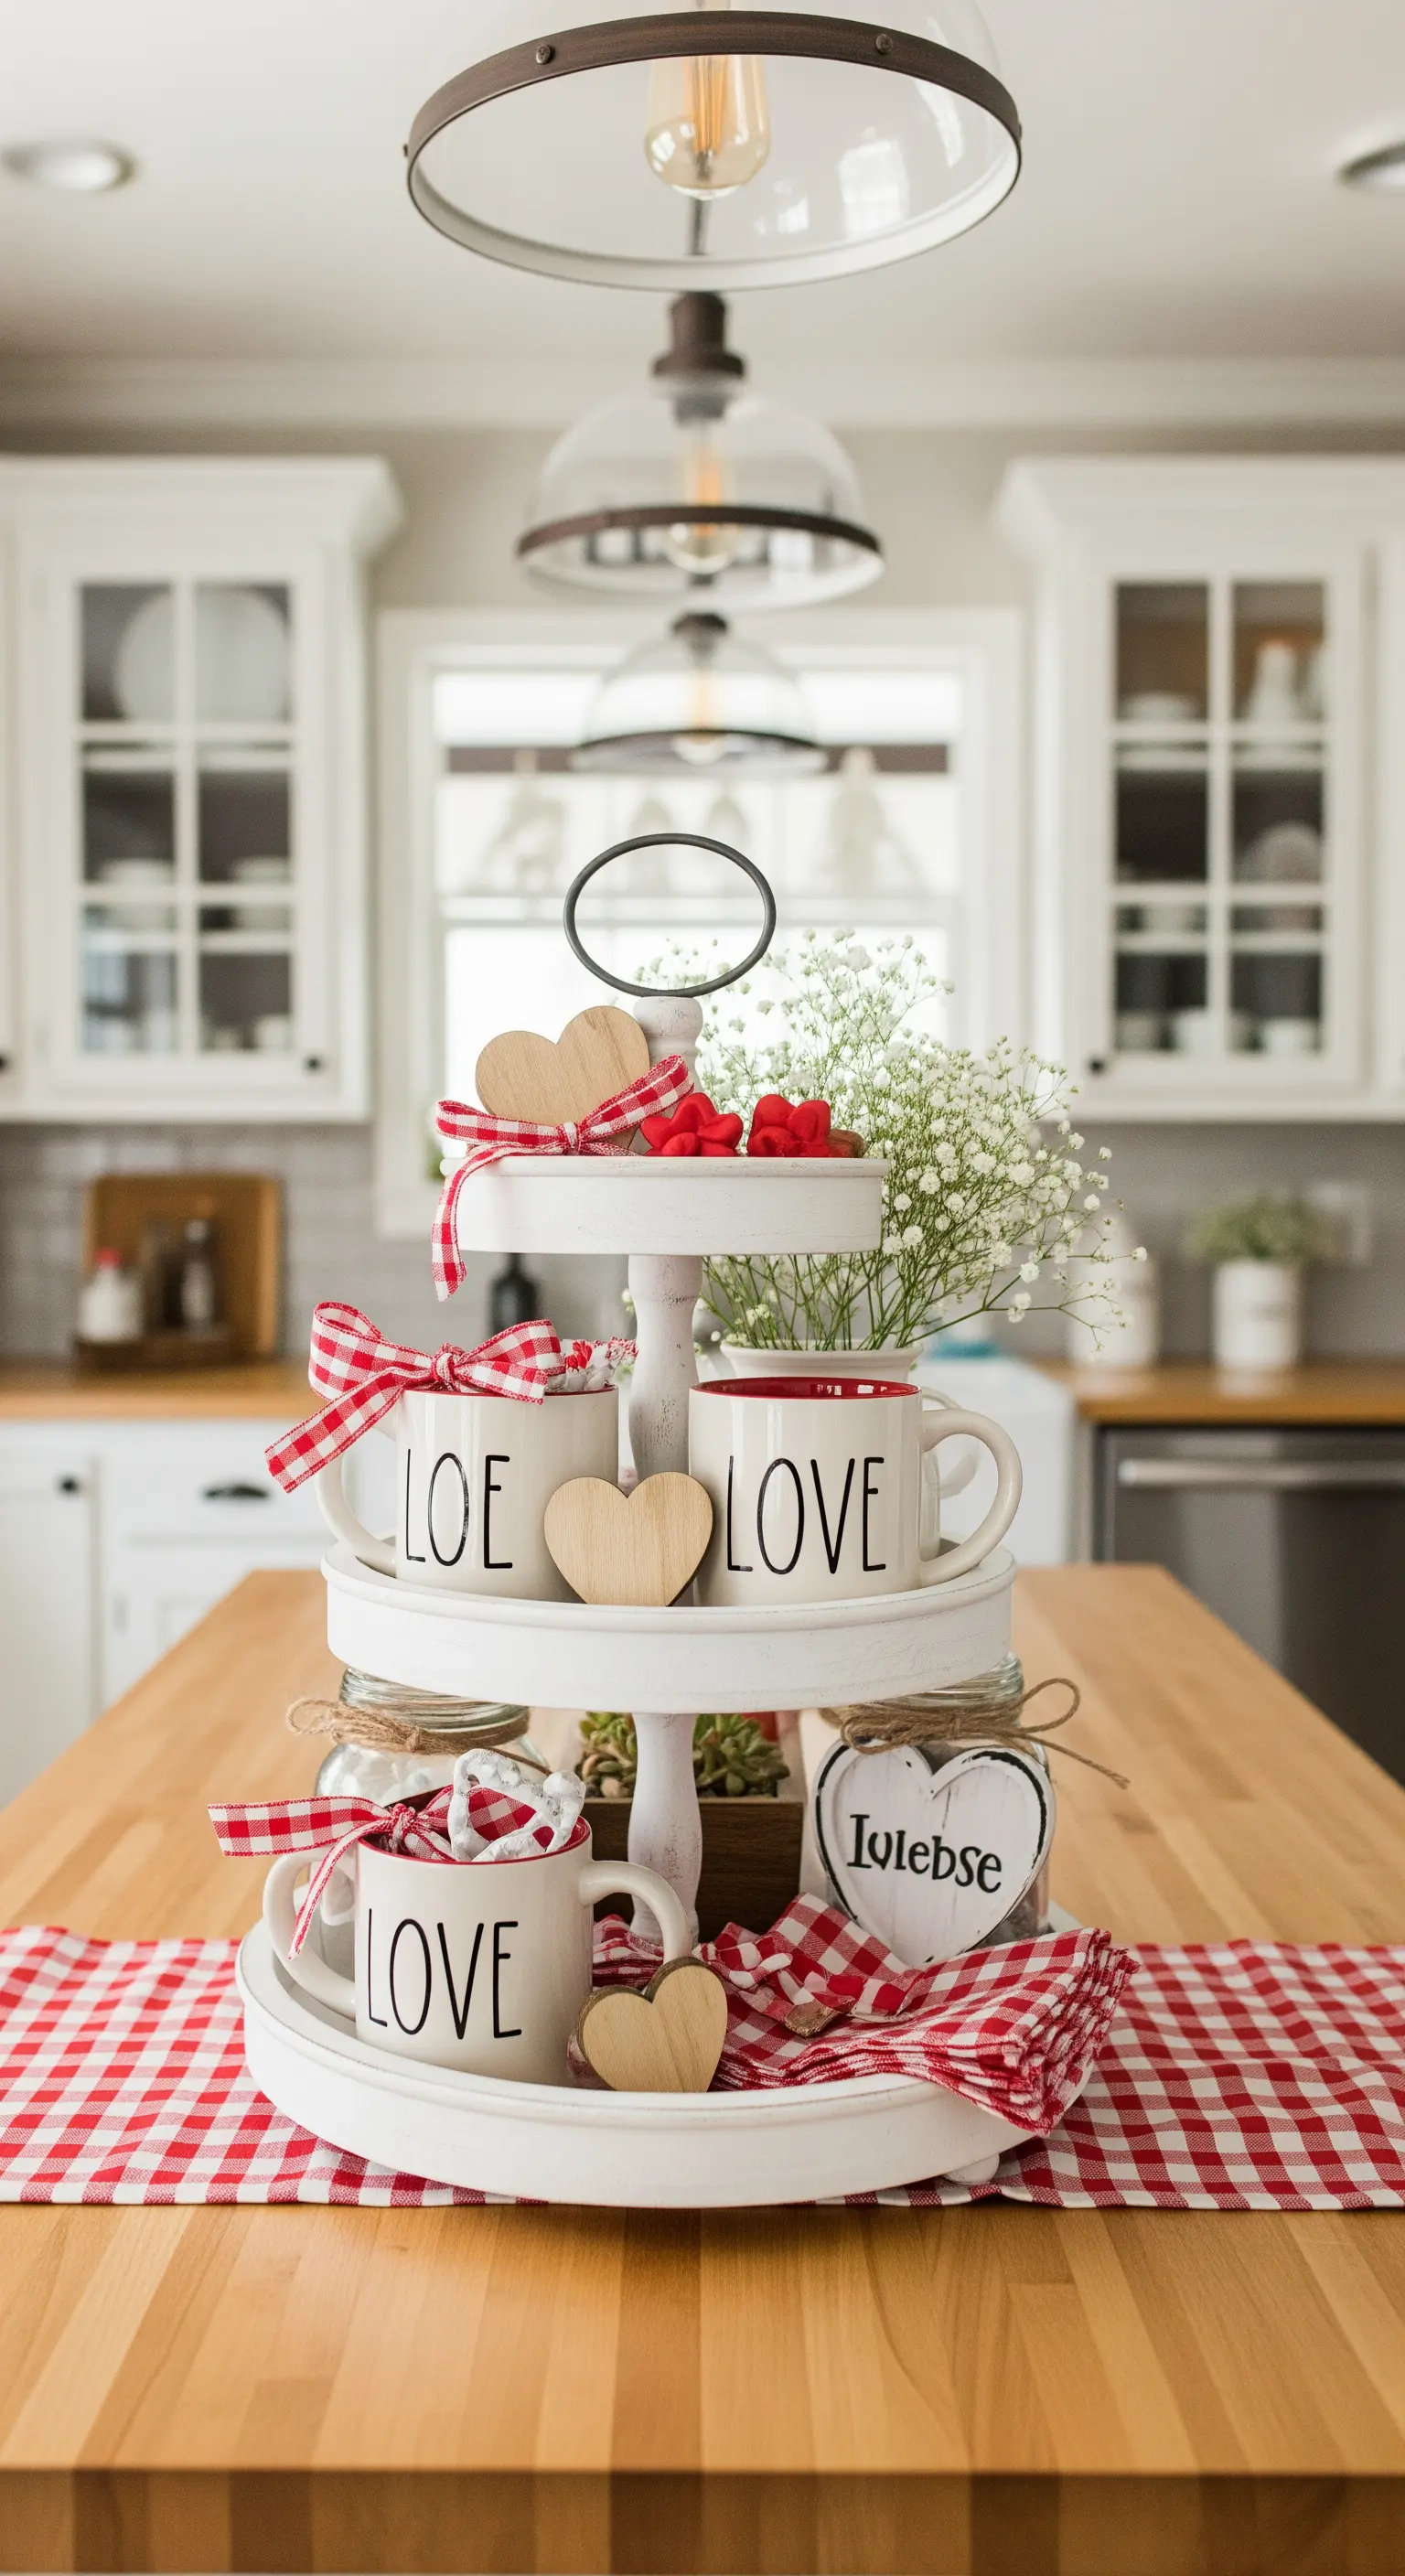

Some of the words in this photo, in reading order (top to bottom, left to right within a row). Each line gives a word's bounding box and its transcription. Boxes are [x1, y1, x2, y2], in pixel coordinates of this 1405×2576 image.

[405, 1448, 513, 1570] LOE
[726, 1454, 887, 1575] LOVE
[368, 1907, 522, 2040] LOVE
